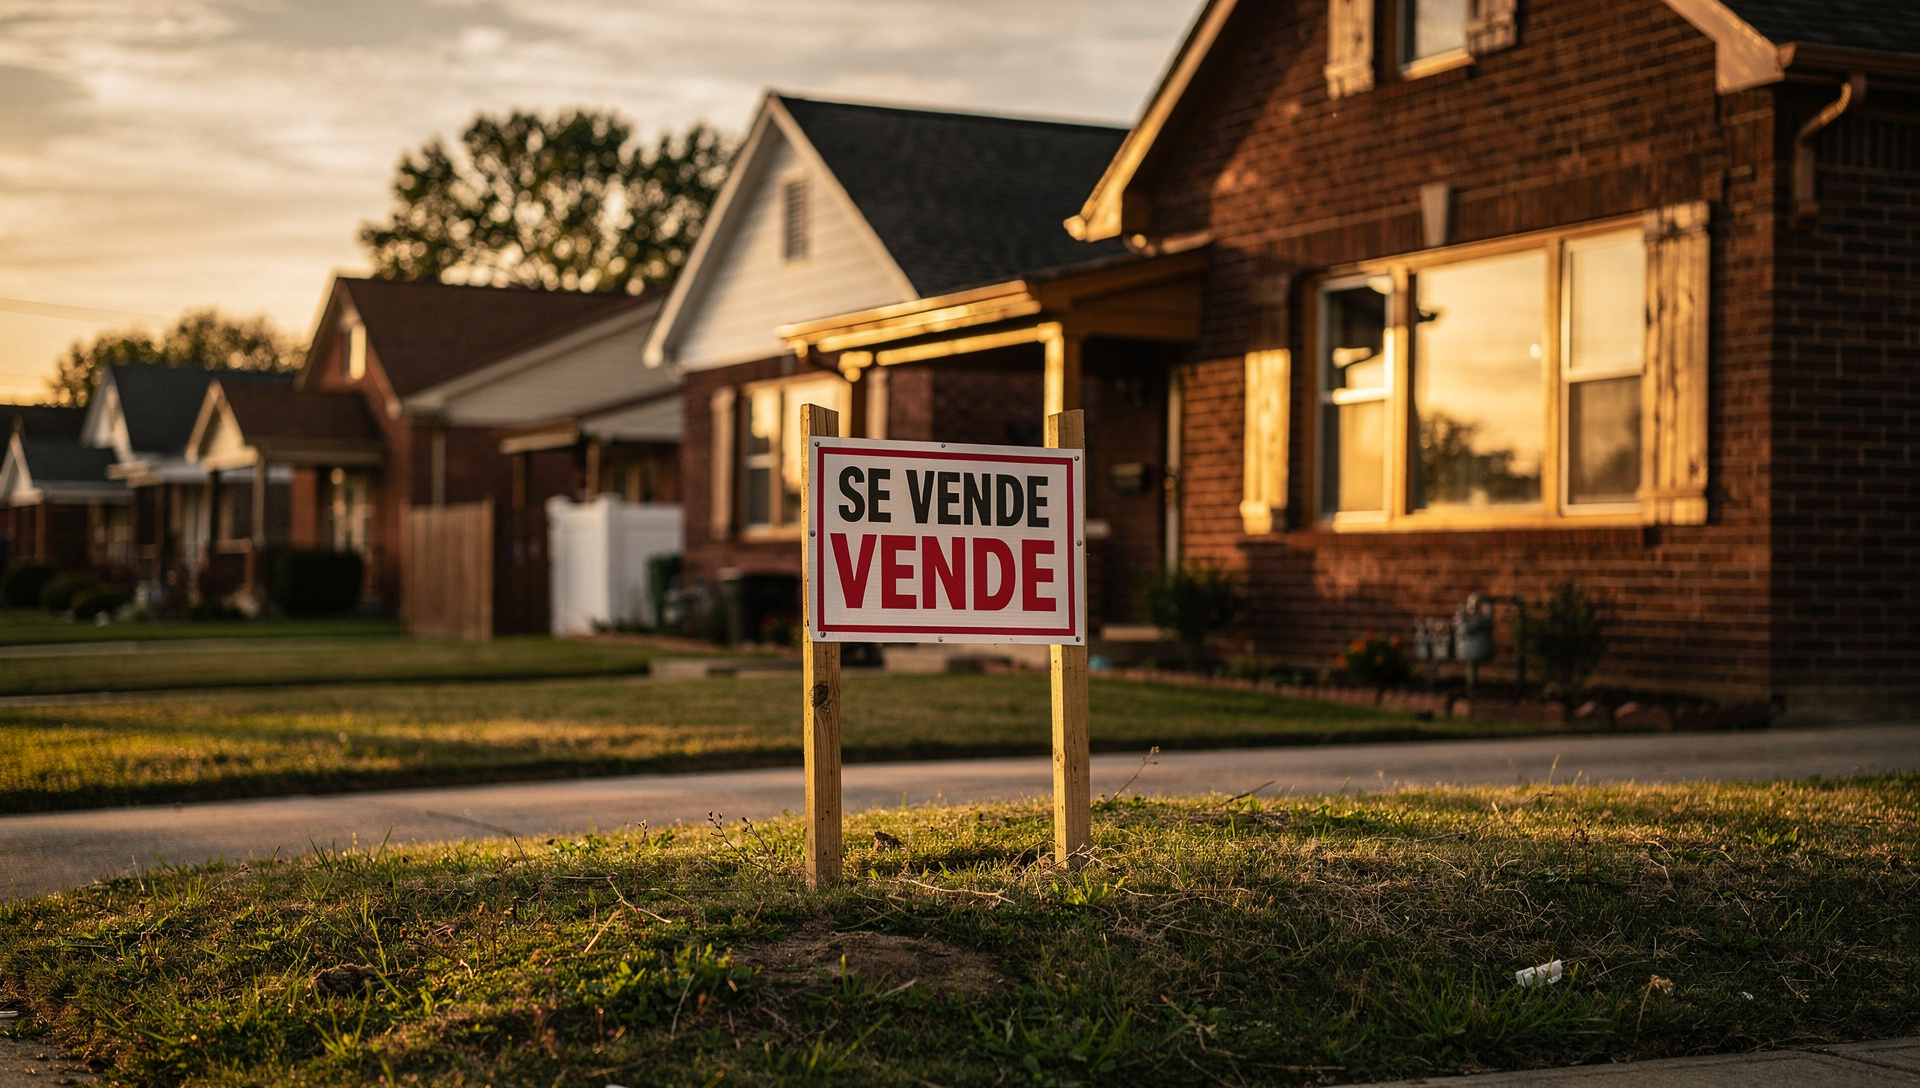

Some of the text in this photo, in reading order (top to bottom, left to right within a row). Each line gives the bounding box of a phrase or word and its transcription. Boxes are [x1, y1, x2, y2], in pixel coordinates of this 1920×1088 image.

[838, 466, 1049, 528] SE VENDE
[829, 532, 1057, 612] VENDE
